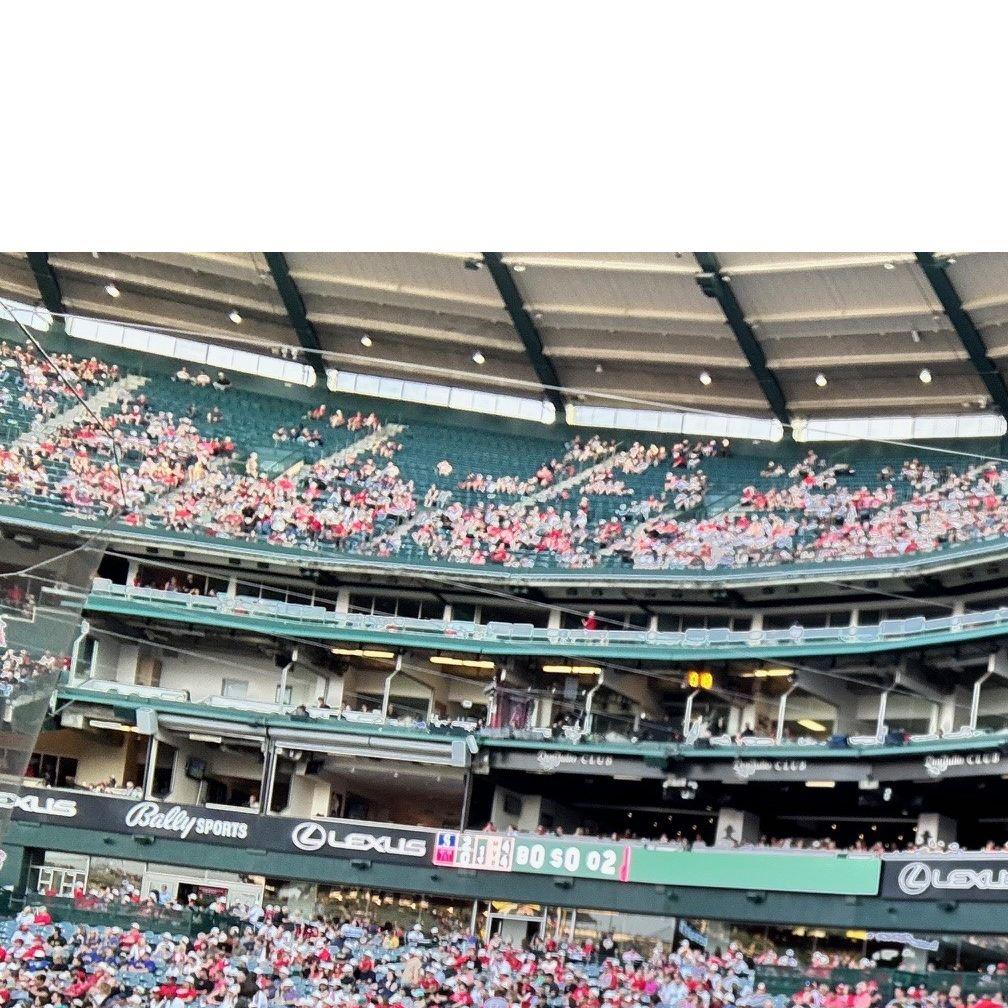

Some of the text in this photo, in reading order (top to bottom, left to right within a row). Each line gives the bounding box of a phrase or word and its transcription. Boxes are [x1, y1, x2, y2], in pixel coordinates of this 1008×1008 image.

[0, 791, 77, 818] EXUS
[125, 801, 248, 839] Bally SPORTS
[327, 830, 427, 857] LEXUS
